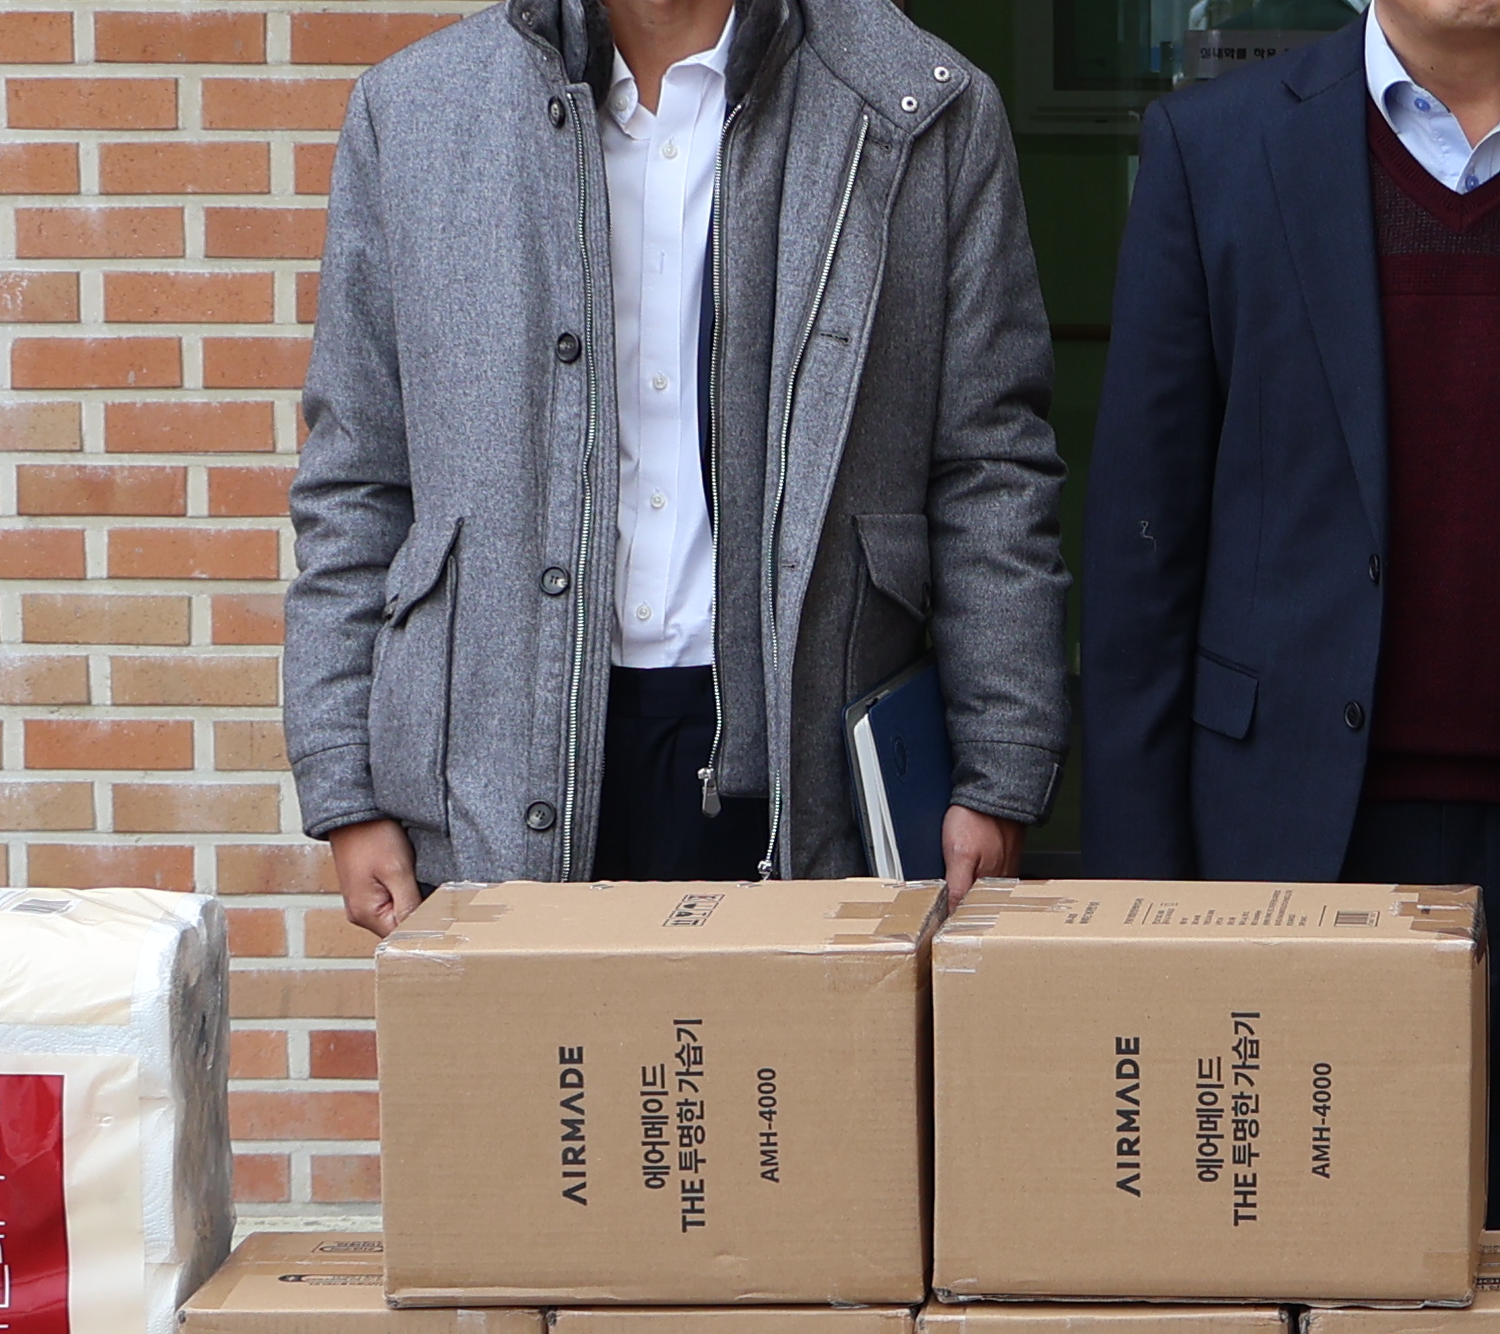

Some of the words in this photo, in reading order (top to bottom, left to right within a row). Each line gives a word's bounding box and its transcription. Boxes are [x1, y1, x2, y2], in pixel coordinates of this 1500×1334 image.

[675, 1018, 703, 1095] 가습기
[1231, 1012, 1260, 1089] 가습기
[559, 1046, 587, 1206] AIRMADE
[642, 1064, 666, 1190] 에어메이드
[678, 1099, 705, 1174] 투명한
[758, 1067, 780, 1183] AMH-4000
[1115, 1036, 1140, 1197] AIRMADE
[1197, 1055, 1222, 1183] 에어메이드
[1232, 1093, 1260, 1169] 투명한
[1311, 1062, 1332, 1179] AMH-4000
[682, 1179, 705, 1232] THE
[1234, 1173, 1257, 1226] THE
